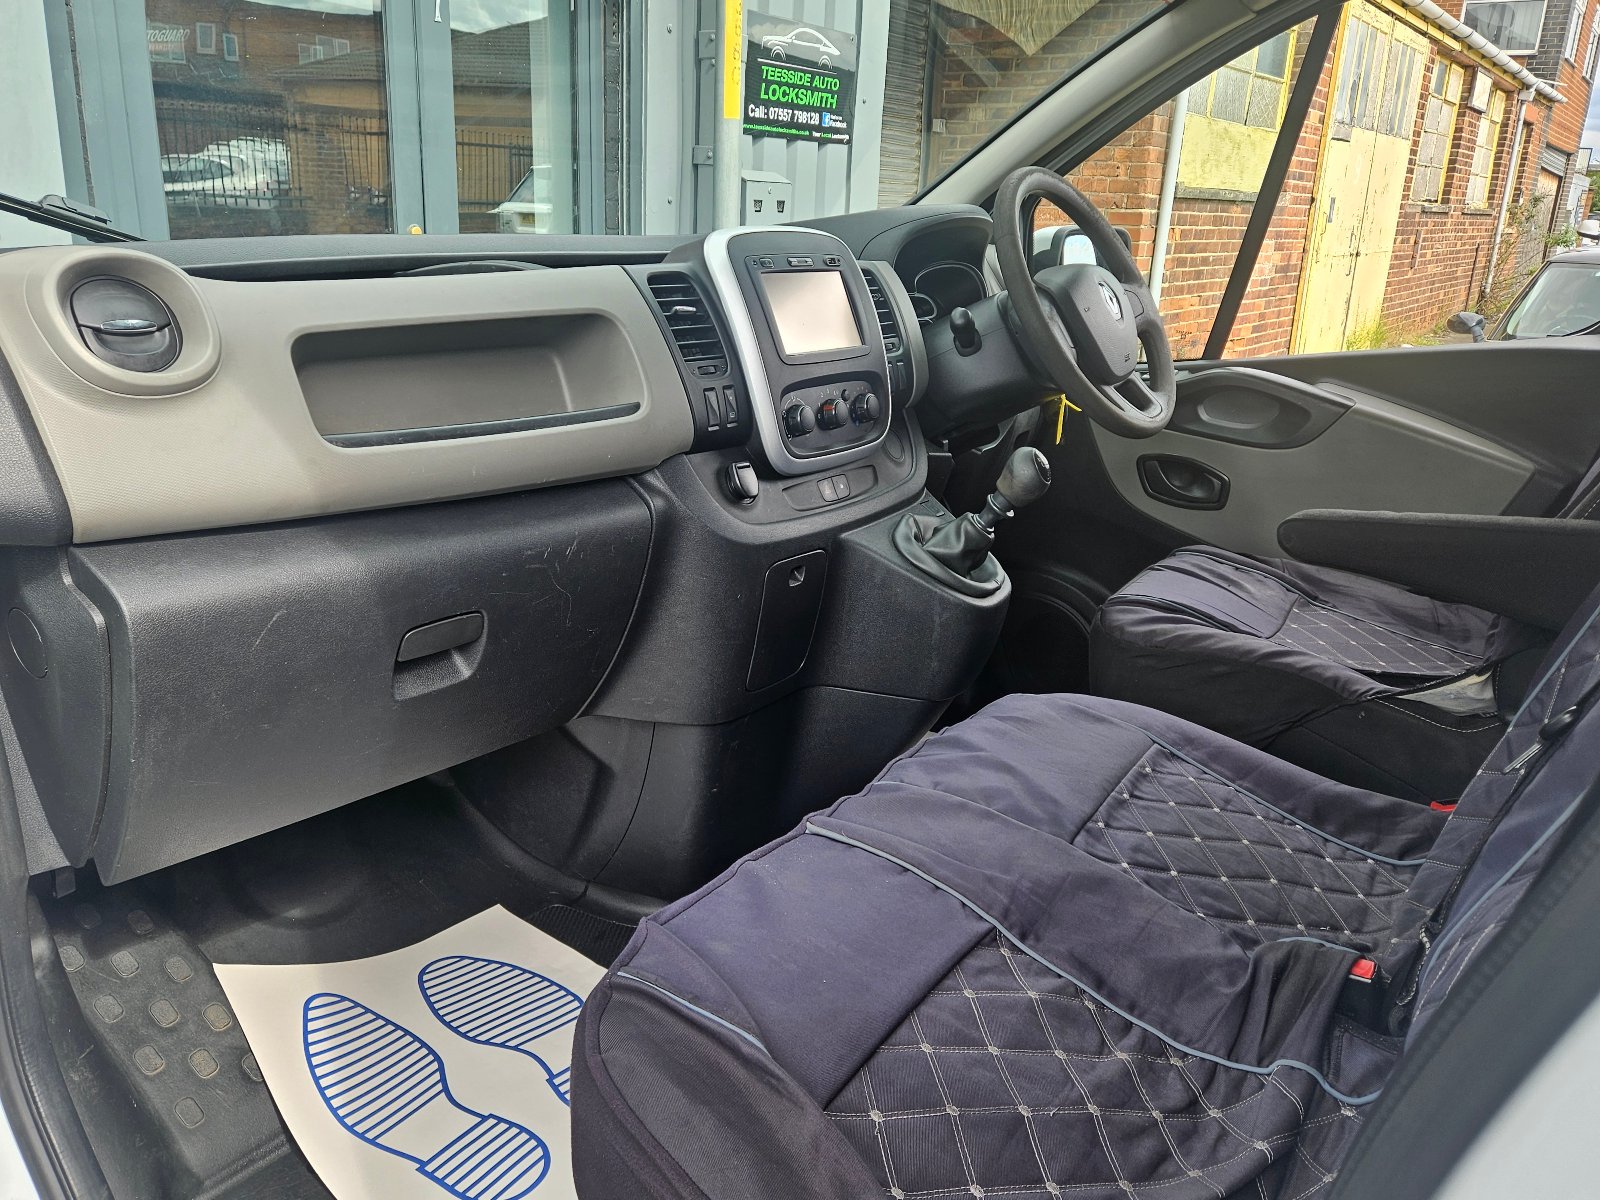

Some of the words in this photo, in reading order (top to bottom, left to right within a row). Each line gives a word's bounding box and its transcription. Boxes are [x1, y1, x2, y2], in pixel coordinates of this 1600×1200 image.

[761, 66, 811, 86] TEESSIDE
[813, 75, 840, 91] AUTO
[760, 82, 838, 109] LOCKSMITH
[748, 104, 768, 119] Call:
[769, 107, 792, 122] 07557
